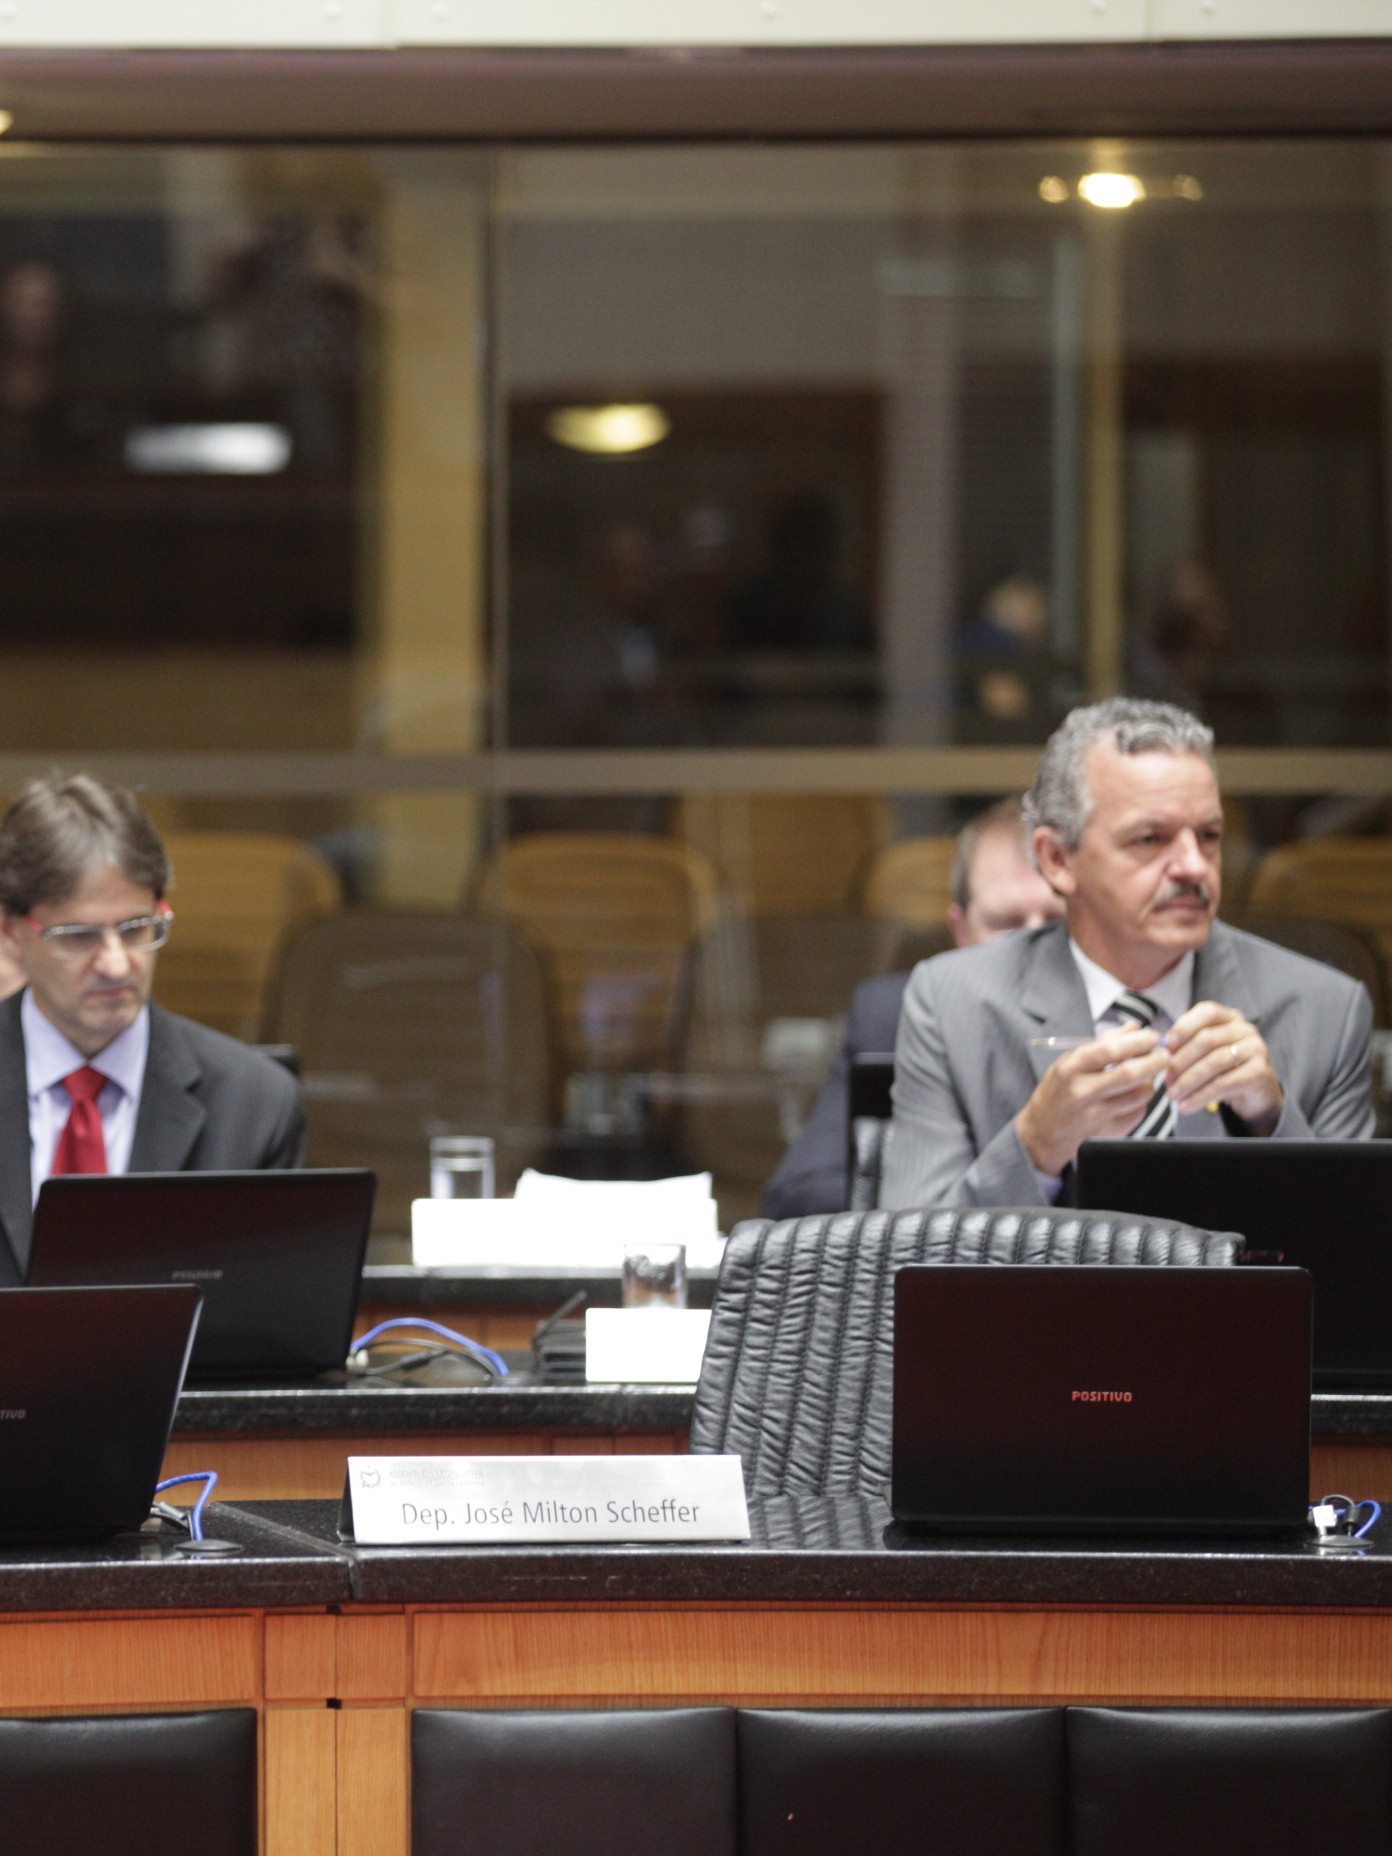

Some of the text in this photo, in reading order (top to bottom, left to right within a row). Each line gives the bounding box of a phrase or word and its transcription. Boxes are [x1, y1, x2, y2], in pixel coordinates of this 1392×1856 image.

[1071, 1391, 1133, 1402] POSITIVO
[401, 1499, 700, 1531] Dep. José Milton Scheffer
